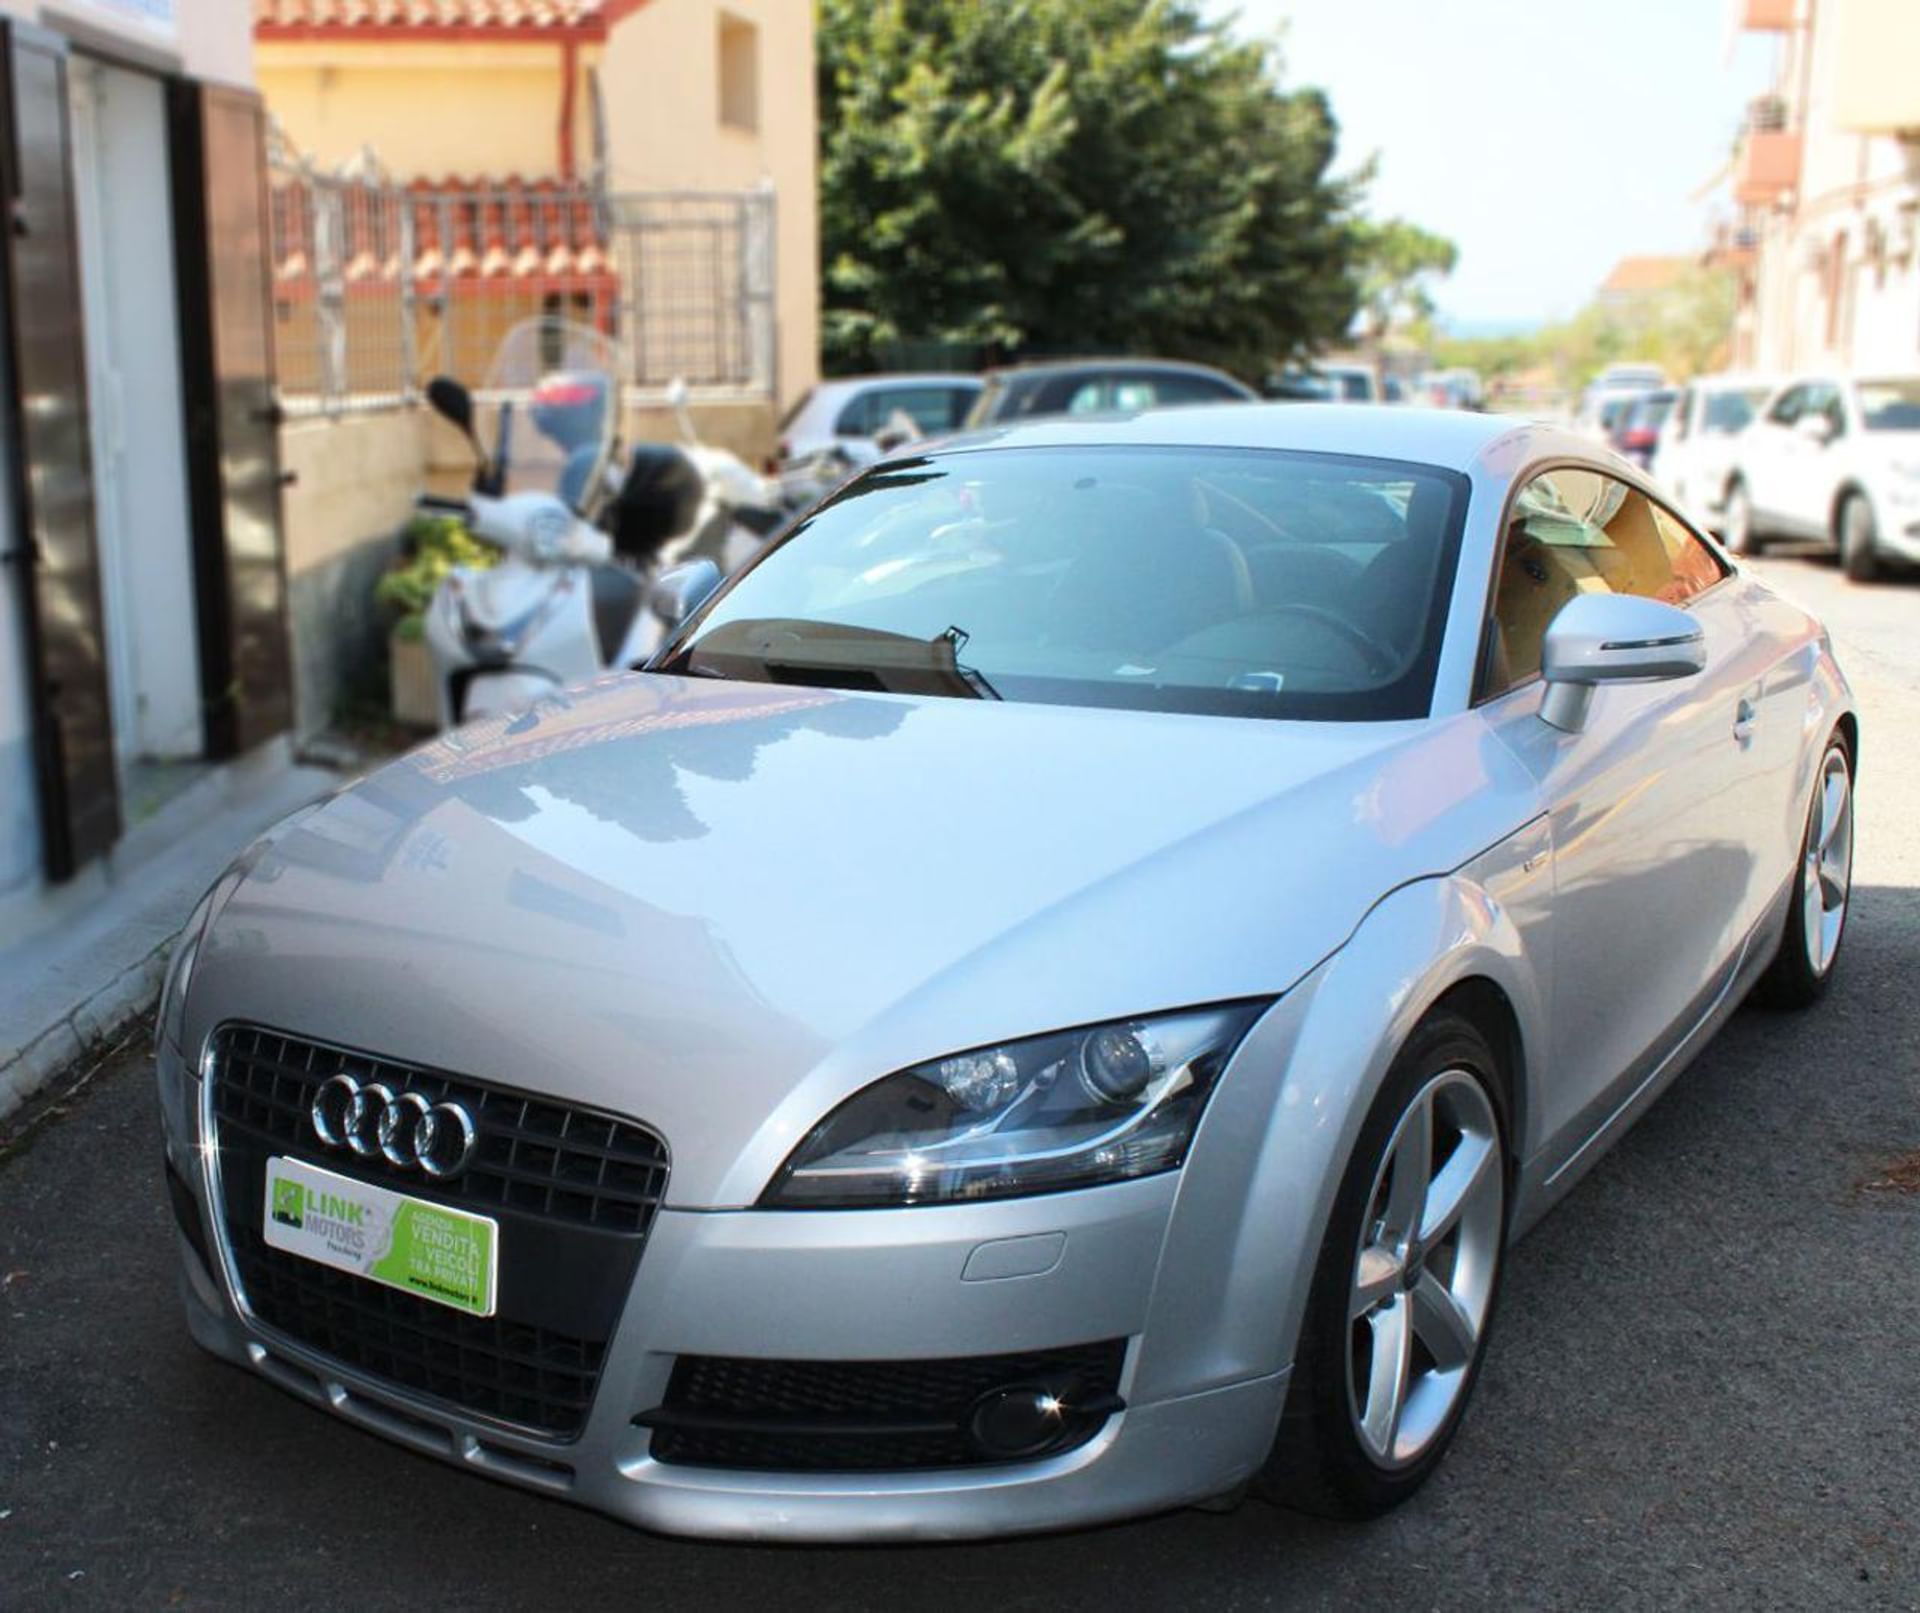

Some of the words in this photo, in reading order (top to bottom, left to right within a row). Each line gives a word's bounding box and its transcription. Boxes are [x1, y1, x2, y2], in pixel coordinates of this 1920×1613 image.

[306, 1188, 364, 1227] LINK
[305, 1213, 366, 1250] MOTORS
[411, 1223, 480, 1256] VENDITA
[426, 1247, 480, 1275] VEICOLI
